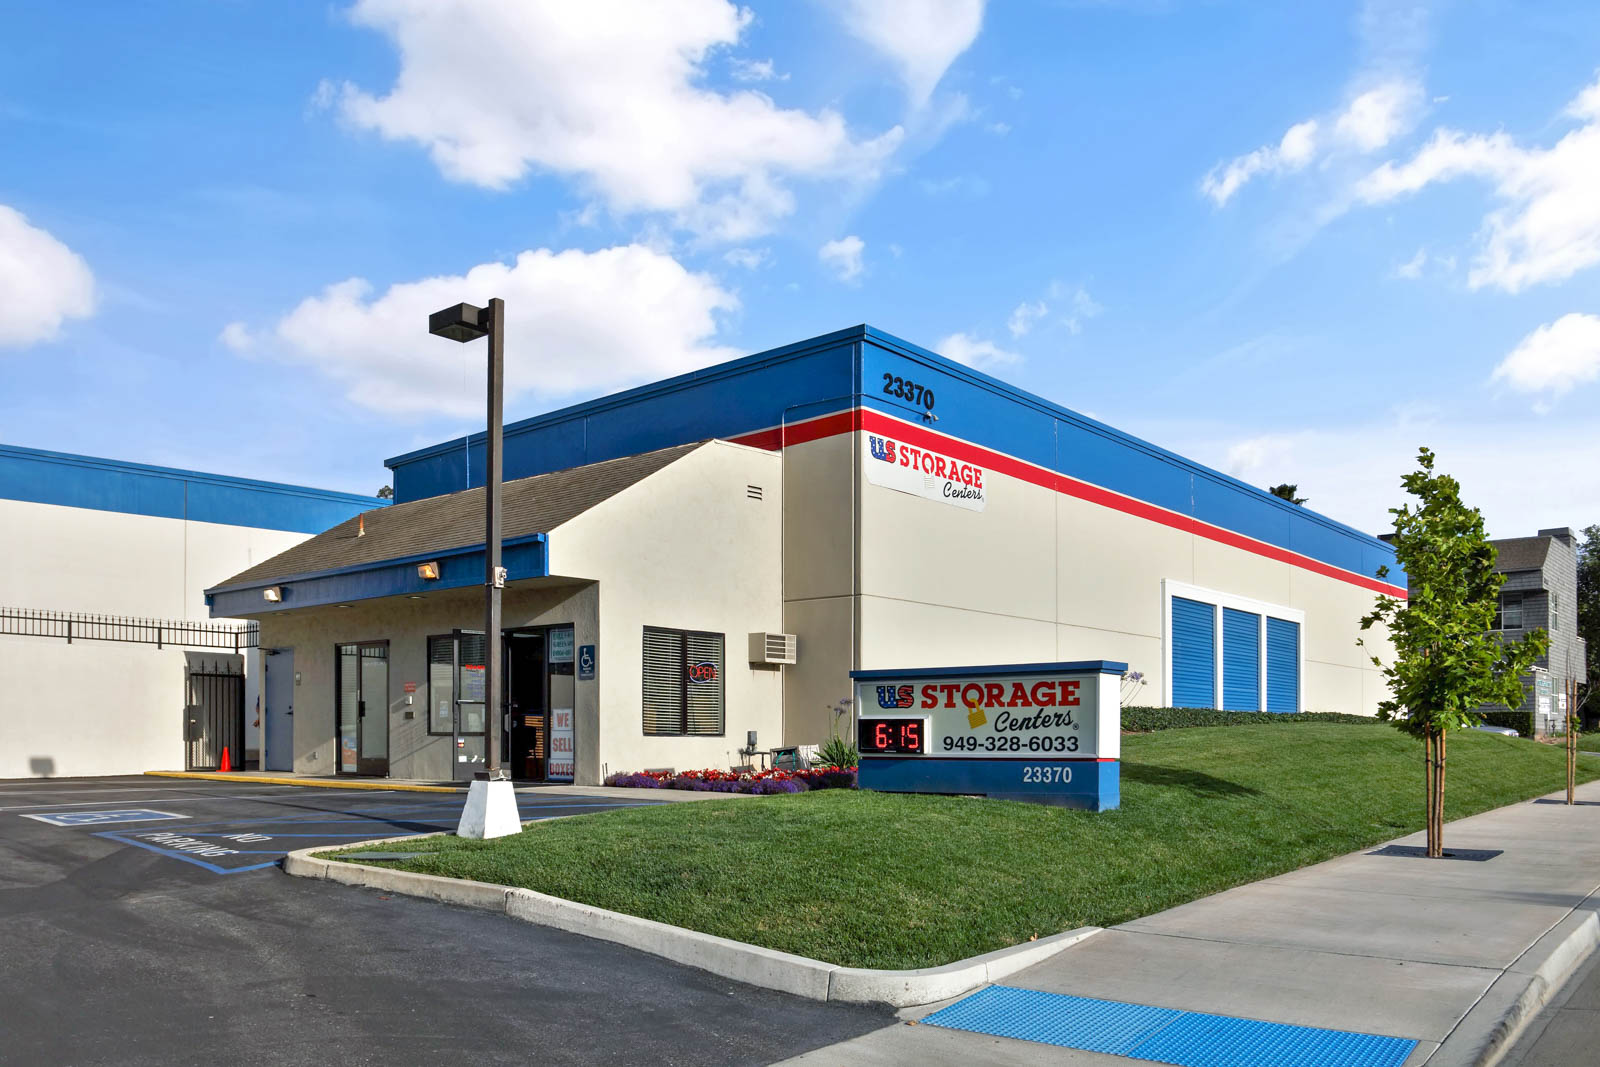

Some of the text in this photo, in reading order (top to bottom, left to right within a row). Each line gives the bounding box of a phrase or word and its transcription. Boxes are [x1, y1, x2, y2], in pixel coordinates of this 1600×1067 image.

[883, 373, 935, 410] 23370
[869, 435, 982, 489] US STORAGE
[943, 481, 983, 500] Centers
[689, 665, 717, 680] OPEN
[876, 680, 1081, 709] US STORAGE
[556, 712, 569, 728] WE
[552, 737, 573, 752] SELL
[875, 723, 919, 749] 6:15
[943, 735, 1079, 752] 949-328-6033
[549, 763, 575, 776] BOXES
[1023, 766, 1073, 783] 23370
[135, 832, 240, 857] PARKING
[221, 833, 273, 843] NO
